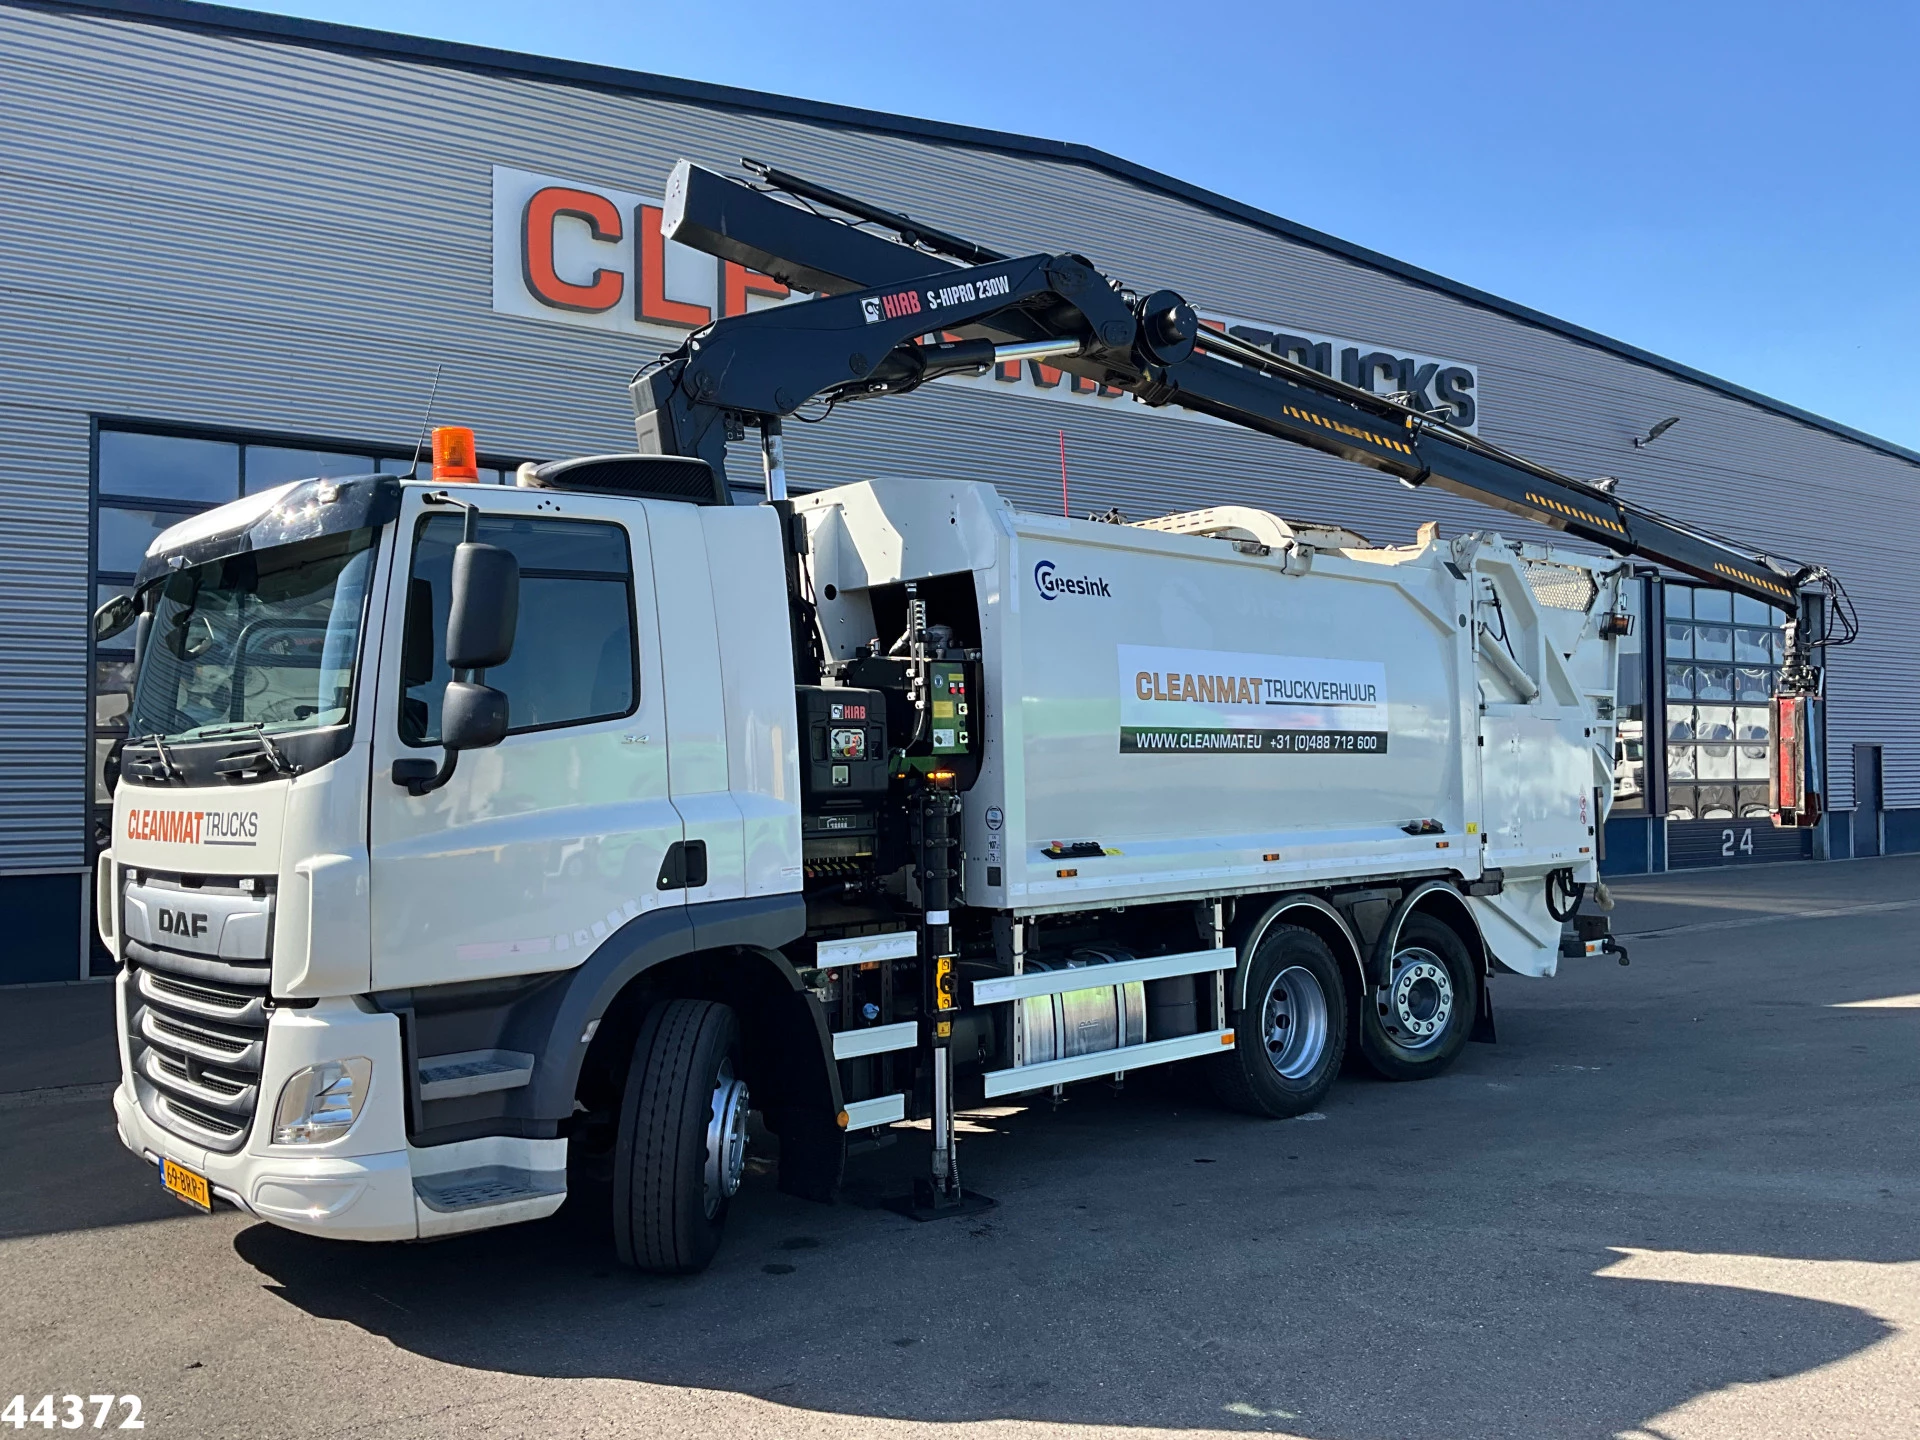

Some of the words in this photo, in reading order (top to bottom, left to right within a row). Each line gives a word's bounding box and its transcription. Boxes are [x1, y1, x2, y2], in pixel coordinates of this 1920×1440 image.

[882, 290, 921, 318] HIAB
[926, 284, 976, 310] S-HIPRO
[977, 276, 1010, 299] 230W
[1040, 569, 1112, 597] Geesink
[1136, 672, 1262, 704] CLEANMAT
[1264, 679, 1376, 702] TRUCKVERHUUR
[844, 705, 866, 719] HIAB
[1136, 733, 1262, 749] WWW.CLEANMAT.EU
[1270, 735, 1290, 749] +31
[1294, 735, 1330, 751] (0)488
[1334, 736, 1354, 749] 712
[1357, 736, 1377, 749] 600
[128, 809, 204, 844] CLEANMAT
[205, 812, 258, 837] TRUCKS
[1722, 829, 1753, 856] 24
[159, 908, 207, 937] DAF
